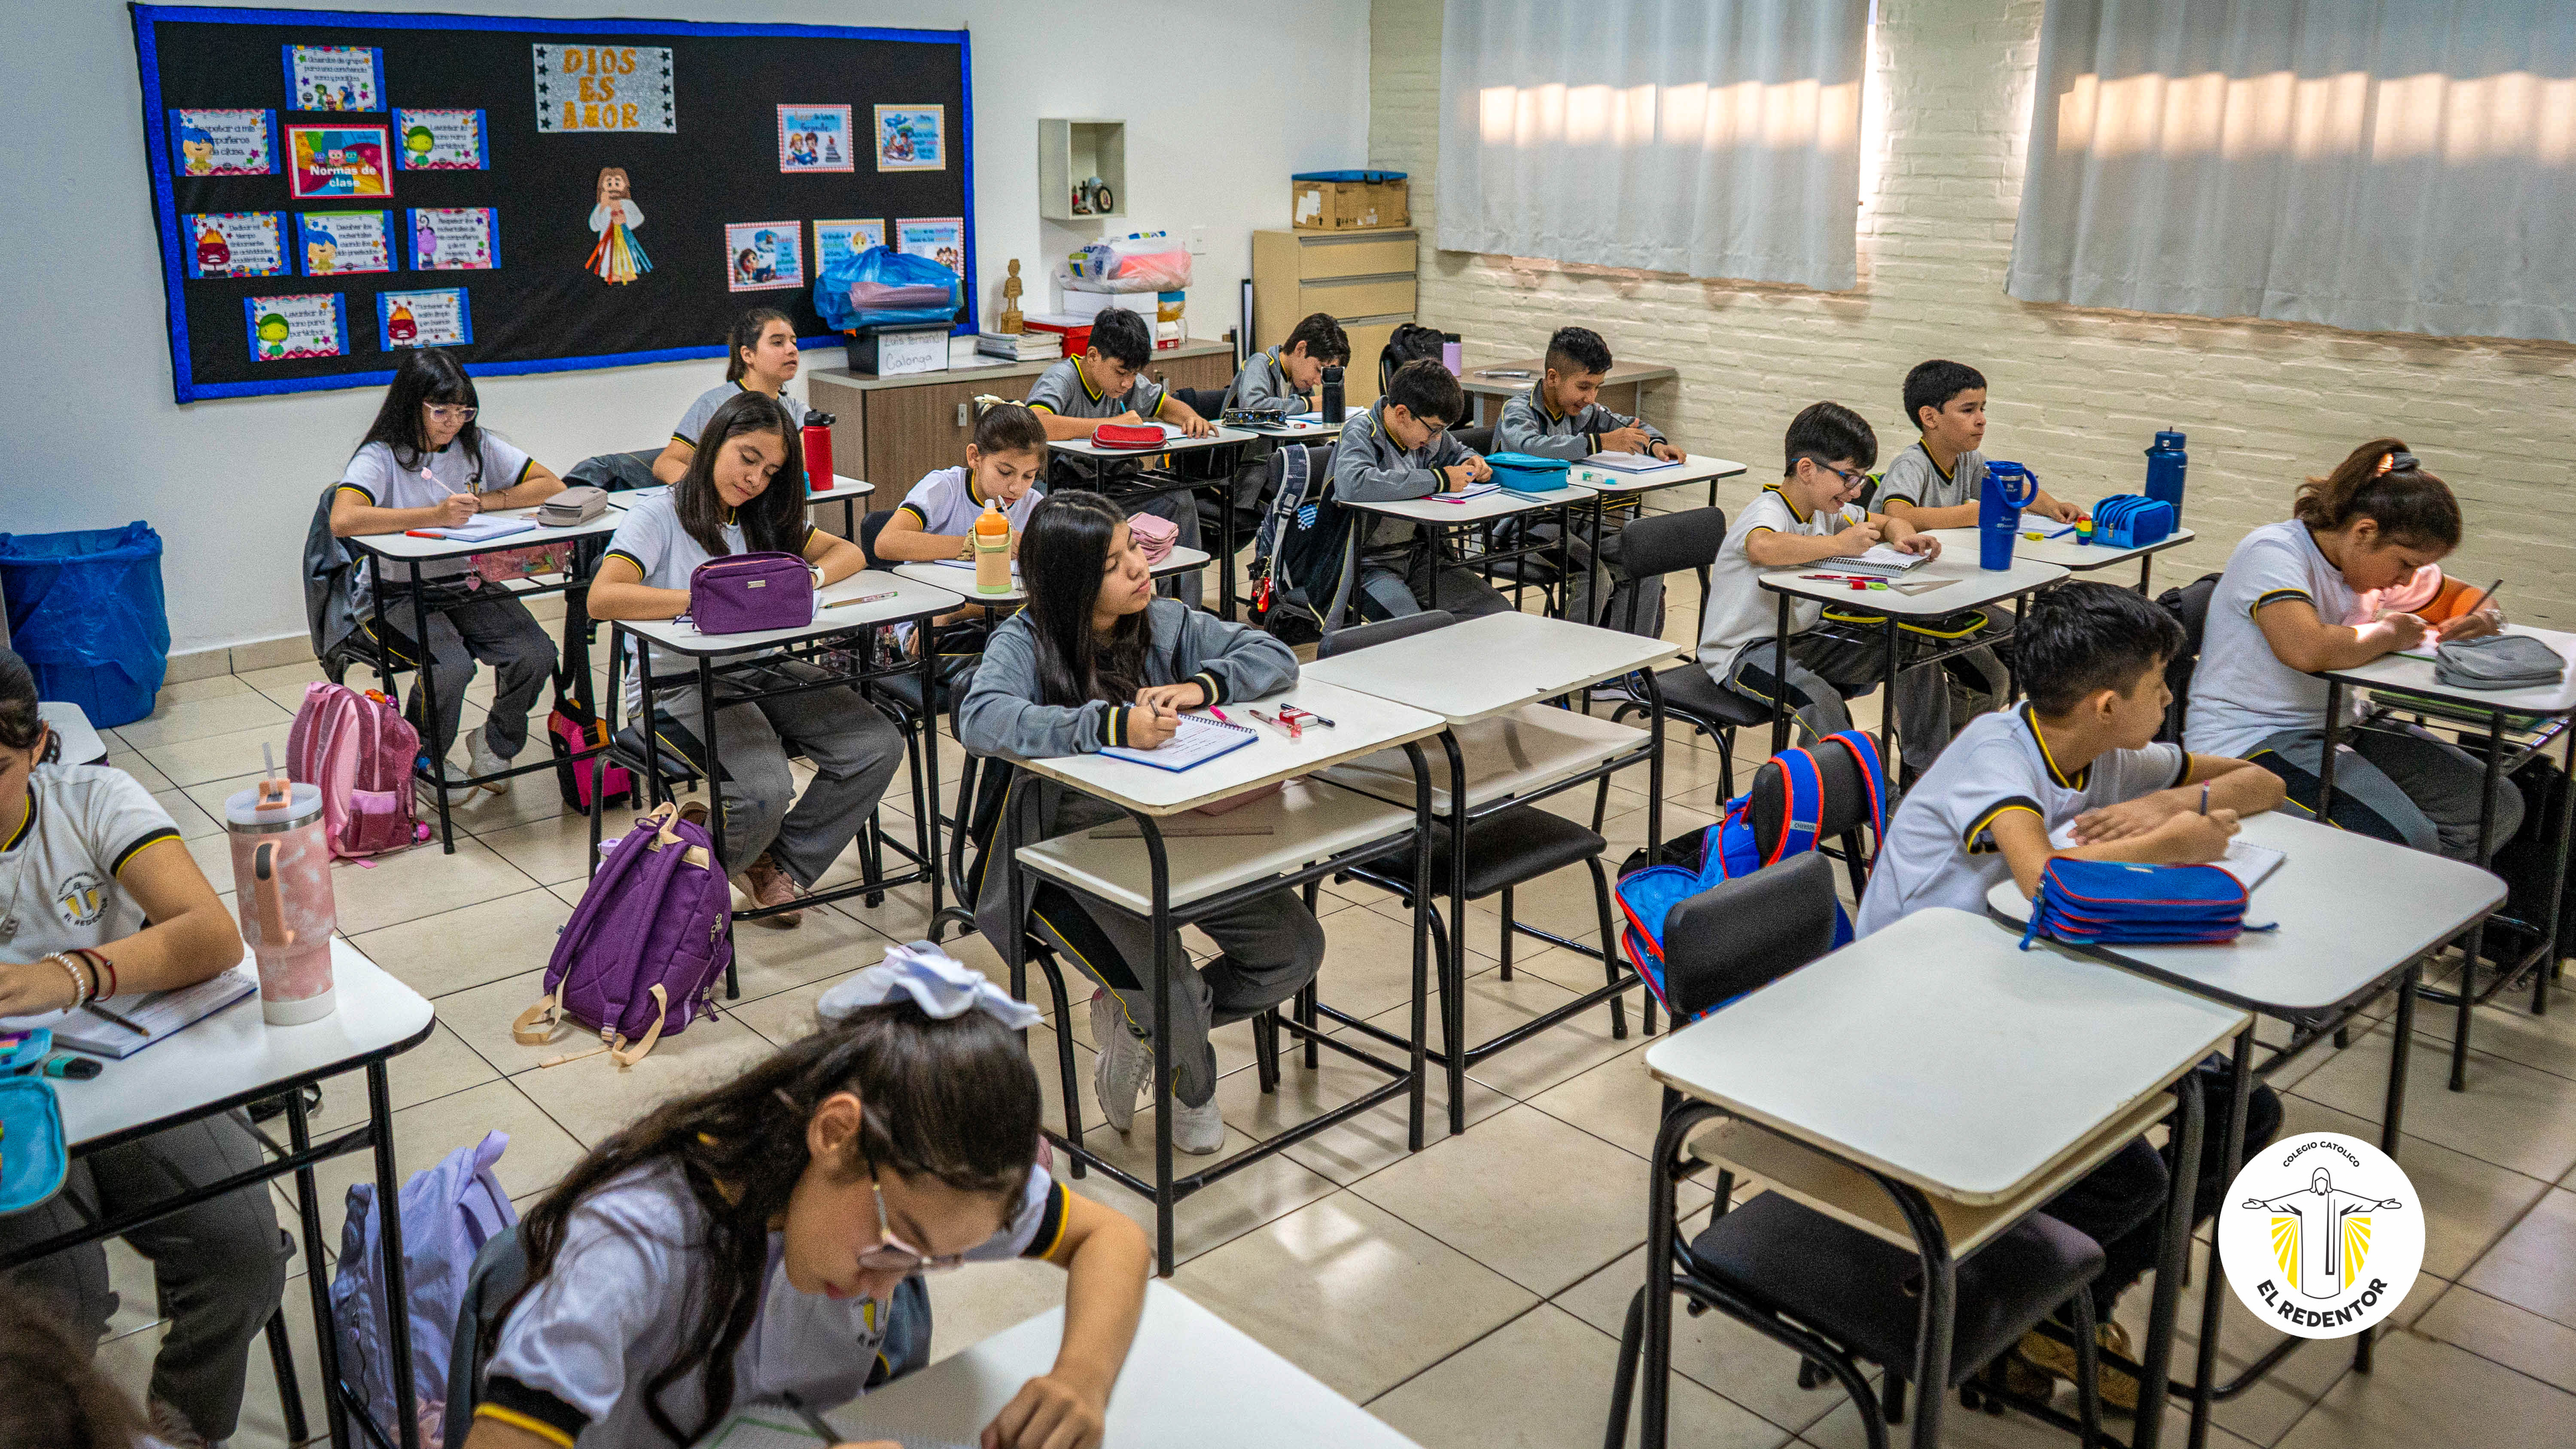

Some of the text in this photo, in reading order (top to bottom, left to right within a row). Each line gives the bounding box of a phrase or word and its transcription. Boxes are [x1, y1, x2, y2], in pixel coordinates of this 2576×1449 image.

[563, 47, 636, 75] DIOS
[579, 76, 615, 102] ES
[562, 100, 639, 129] AMOR
[310, 164, 377, 176] Normas de
[329, 177, 361, 187] clase
